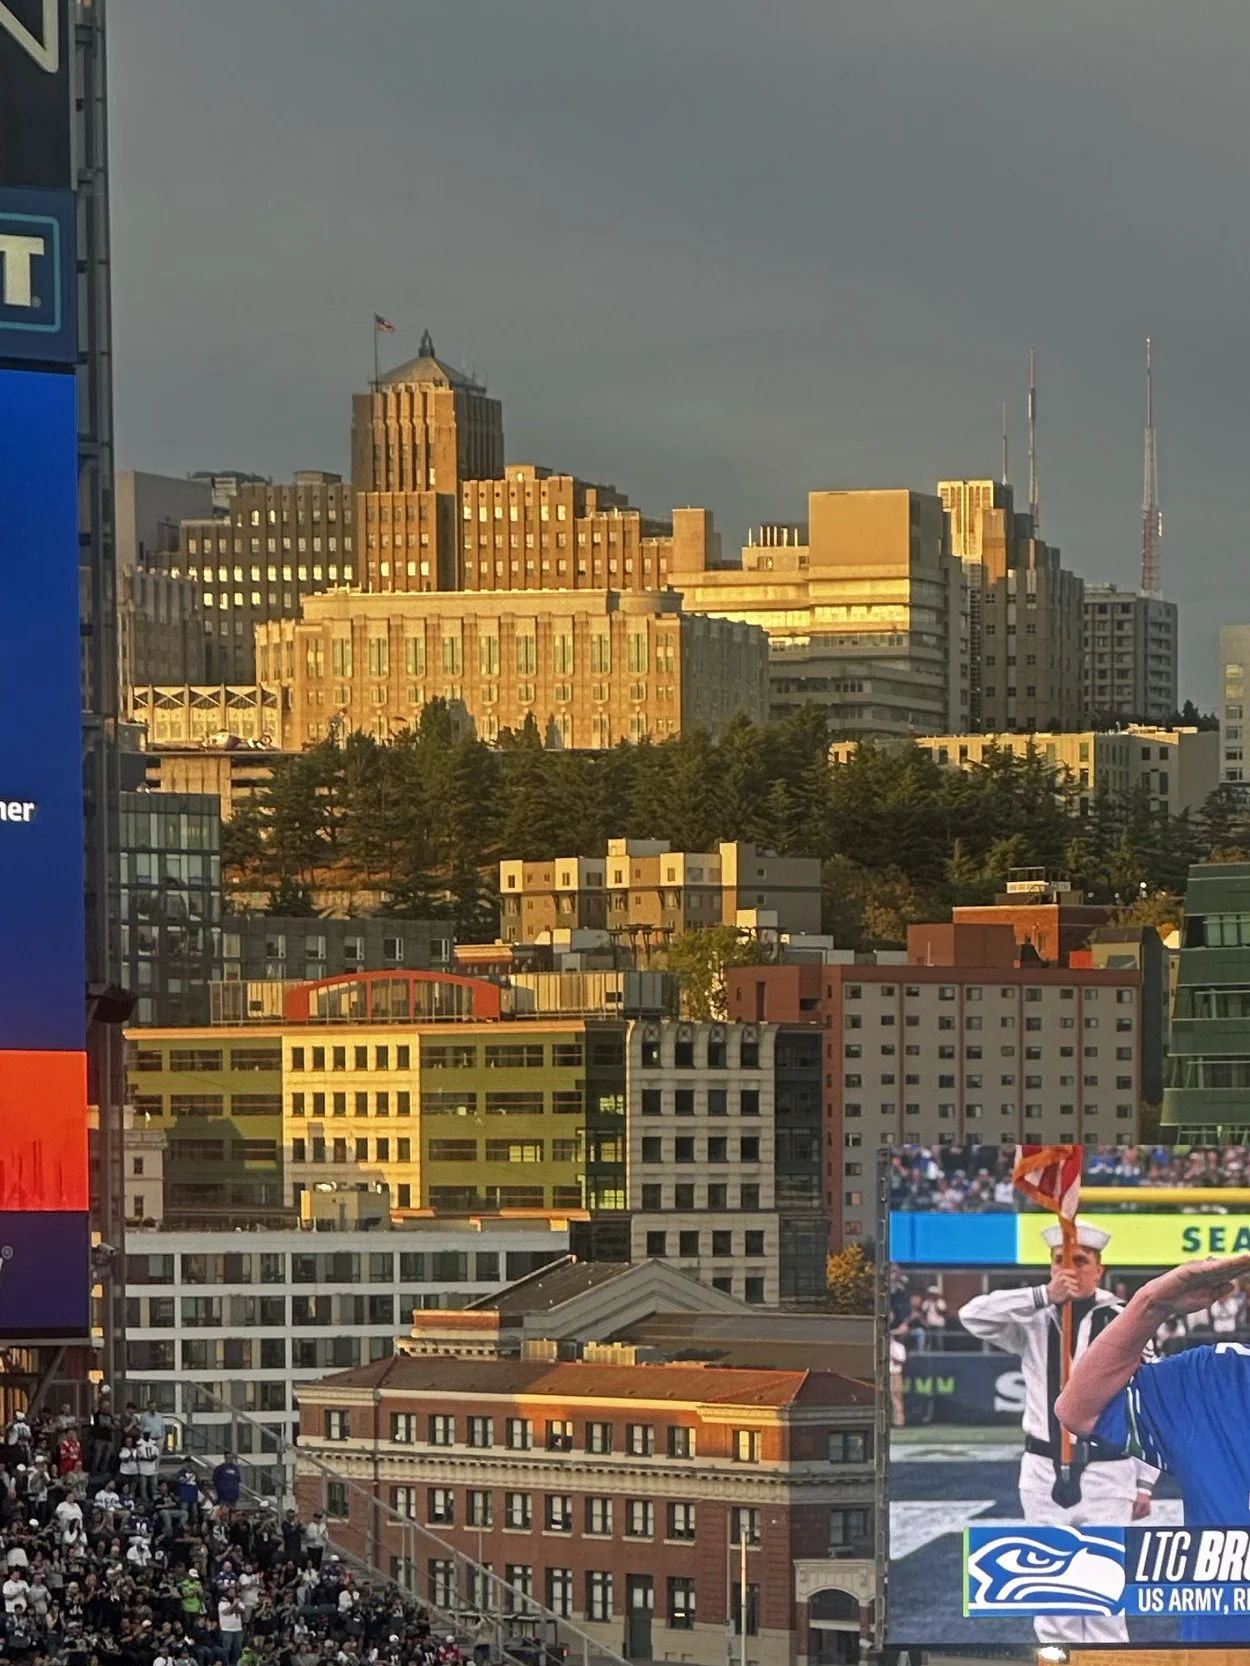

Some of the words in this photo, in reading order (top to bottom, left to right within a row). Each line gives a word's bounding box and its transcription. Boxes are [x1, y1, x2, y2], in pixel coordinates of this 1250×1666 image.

[1136, 1531, 1190, 1582] LTC
[1138, 1588, 1167, 1612] US
[1170, 1588, 1230, 1616] ARMY,
